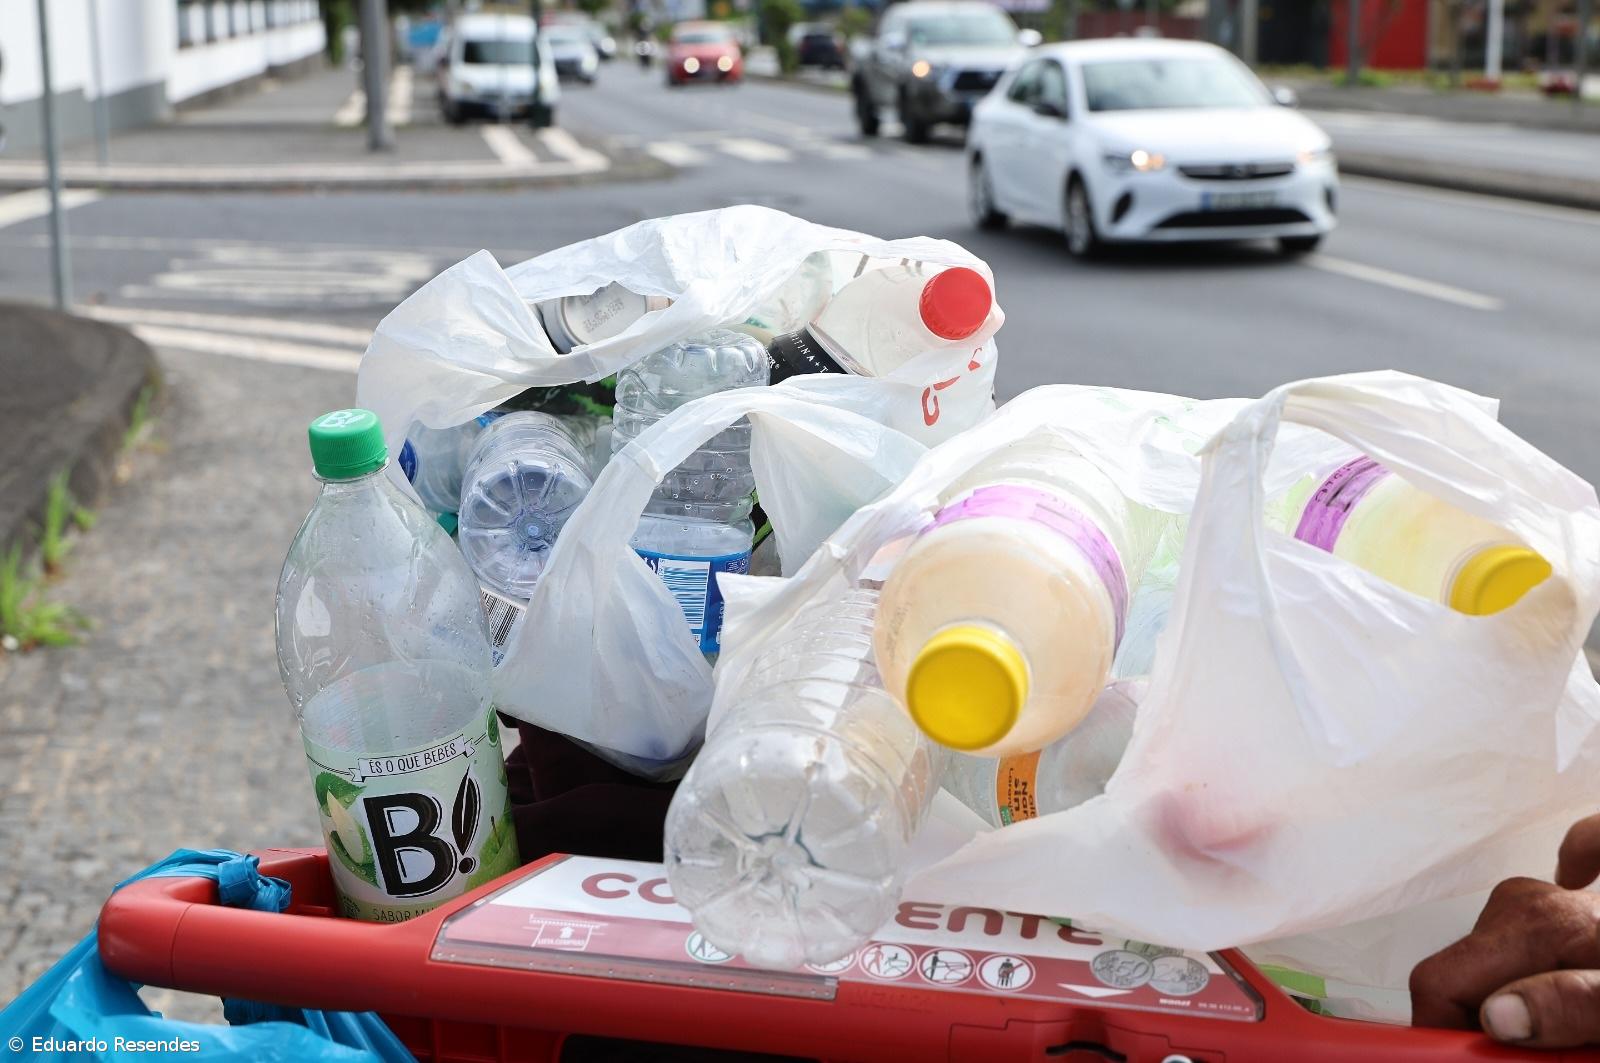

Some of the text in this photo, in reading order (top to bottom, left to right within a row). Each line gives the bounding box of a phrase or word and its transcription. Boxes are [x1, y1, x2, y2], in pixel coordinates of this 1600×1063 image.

[368, 742, 457, 774] ÉS O QUE BEBES
[373, 908, 411, 922] SABOR
